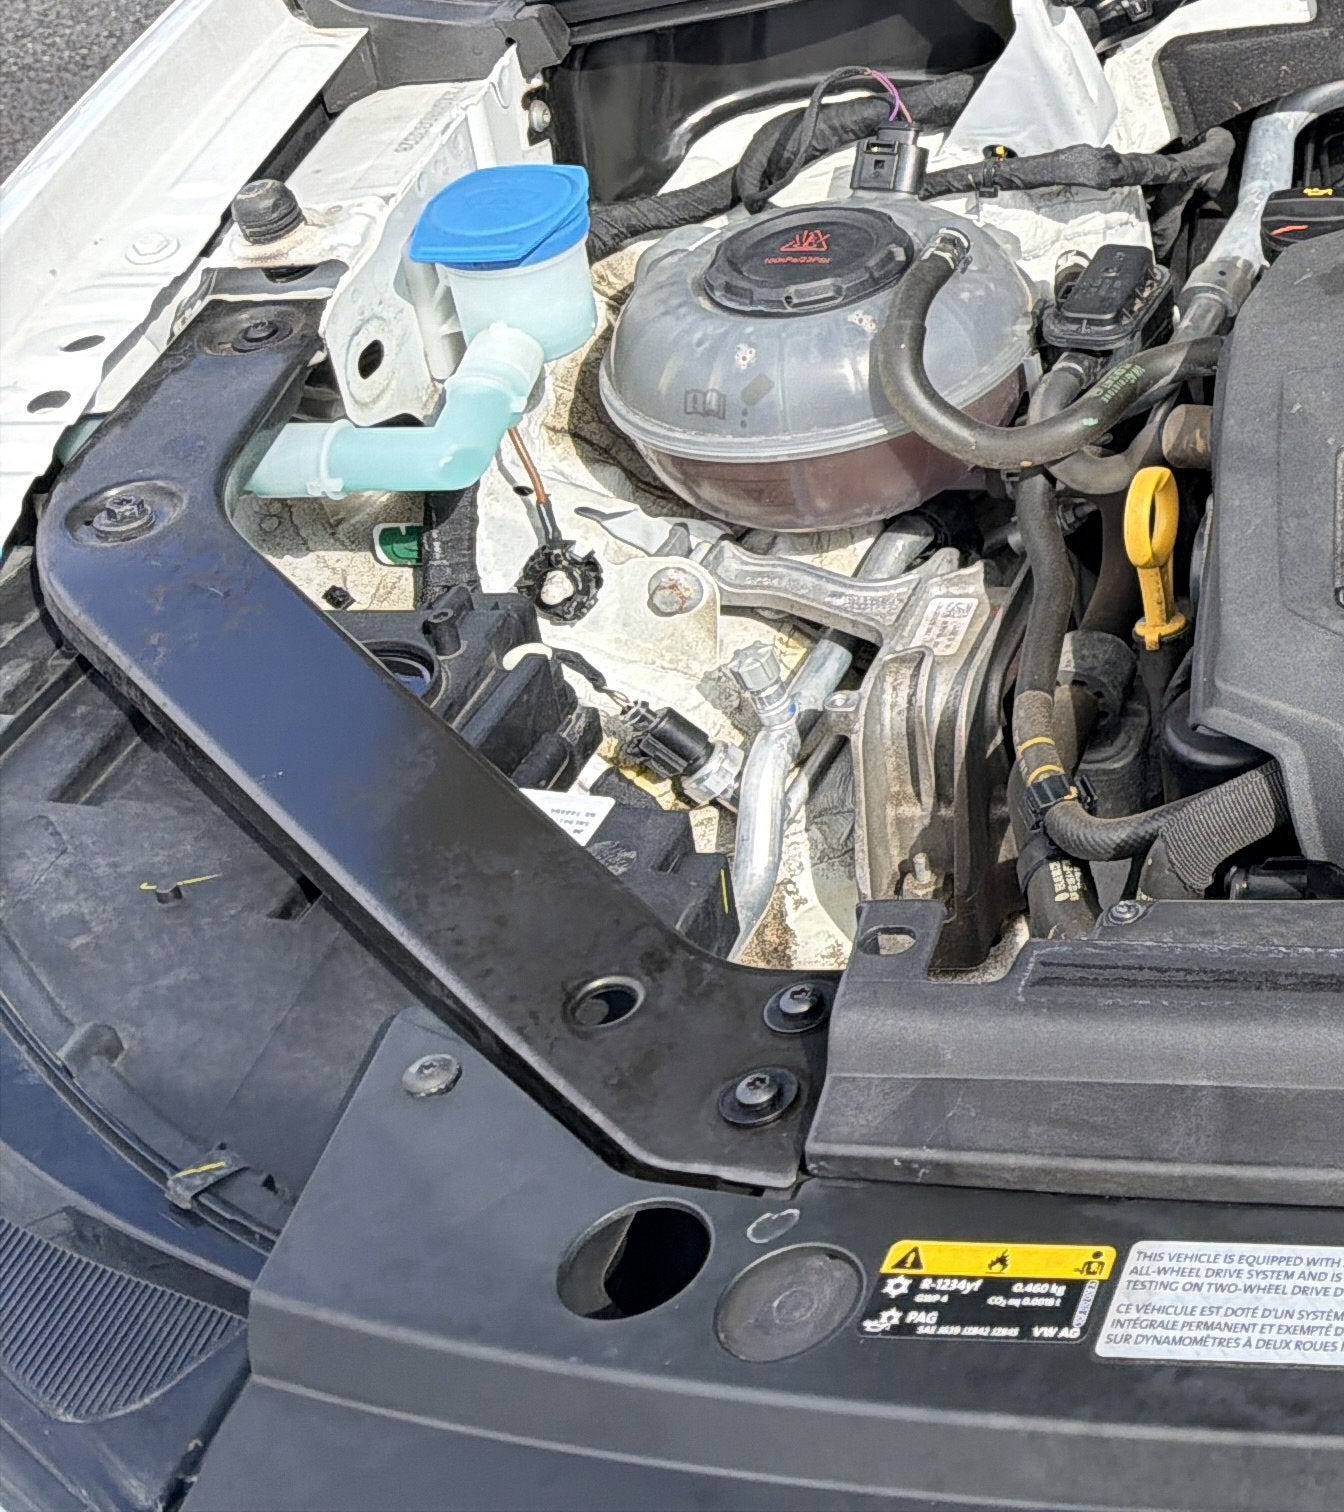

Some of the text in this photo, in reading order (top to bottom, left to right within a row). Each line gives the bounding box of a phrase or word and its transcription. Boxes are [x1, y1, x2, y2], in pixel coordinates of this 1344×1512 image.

[1136, 1251, 1164, 1262] THIS
[1168, 1252, 1220, 1264] VEHICLE
[1238, 1255, 1303, 1267] EQUIPPED
[1307, 1257, 1340, 1268] WITH
[1129, 1266, 1201, 1278] ALL-WHEEL
[1204, 1268, 1243, 1279] DRIVE
[1246, 1270, 1295, 1280] SYSTEM
[1297, 1272, 1328, 1282] AND
[919, 1278, 984, 1294] R-1234yf
[1125, 1280, 1180, 1291] TESTING
[1182, 1282, 1204, 1292] ON
[1206, 1283, 1288, 1296] TWO-WHEEL
[1291, 1285, 1331, 1297] DRIVE
[905, 1311, 939, 1324] PAG
[1116, 1303, 1133, 1314] CE
[1136, 1303, 1197, 1316] VÉHICULE
[1199, 1306, 1222, 1316] EST
[1224, 1305, 1259, 1318] DOTÉ
[1261, 1308, 1295, 1319] D'UN
[1032, 1327, 1058, 1338] VW
[1057, 1328, 1080, 1338] AG
[1111, 1317, 1178, 1330] INTÉGRALE
[1180, 1321, 1258, 1334] PERMANENT
[1260, 1323, 1274, 1334] ET
[1276, 1323, 1331, 1337] EXEMPTÉ
[1105, 1333, 1131, 1344] SUR
[1134, 1334, 1241, 1349] DYNAMOMÈTRES
[1255, 1339, 1293, 1350] DEUX
[1295, 1341, 1338, 1352] ROUES
